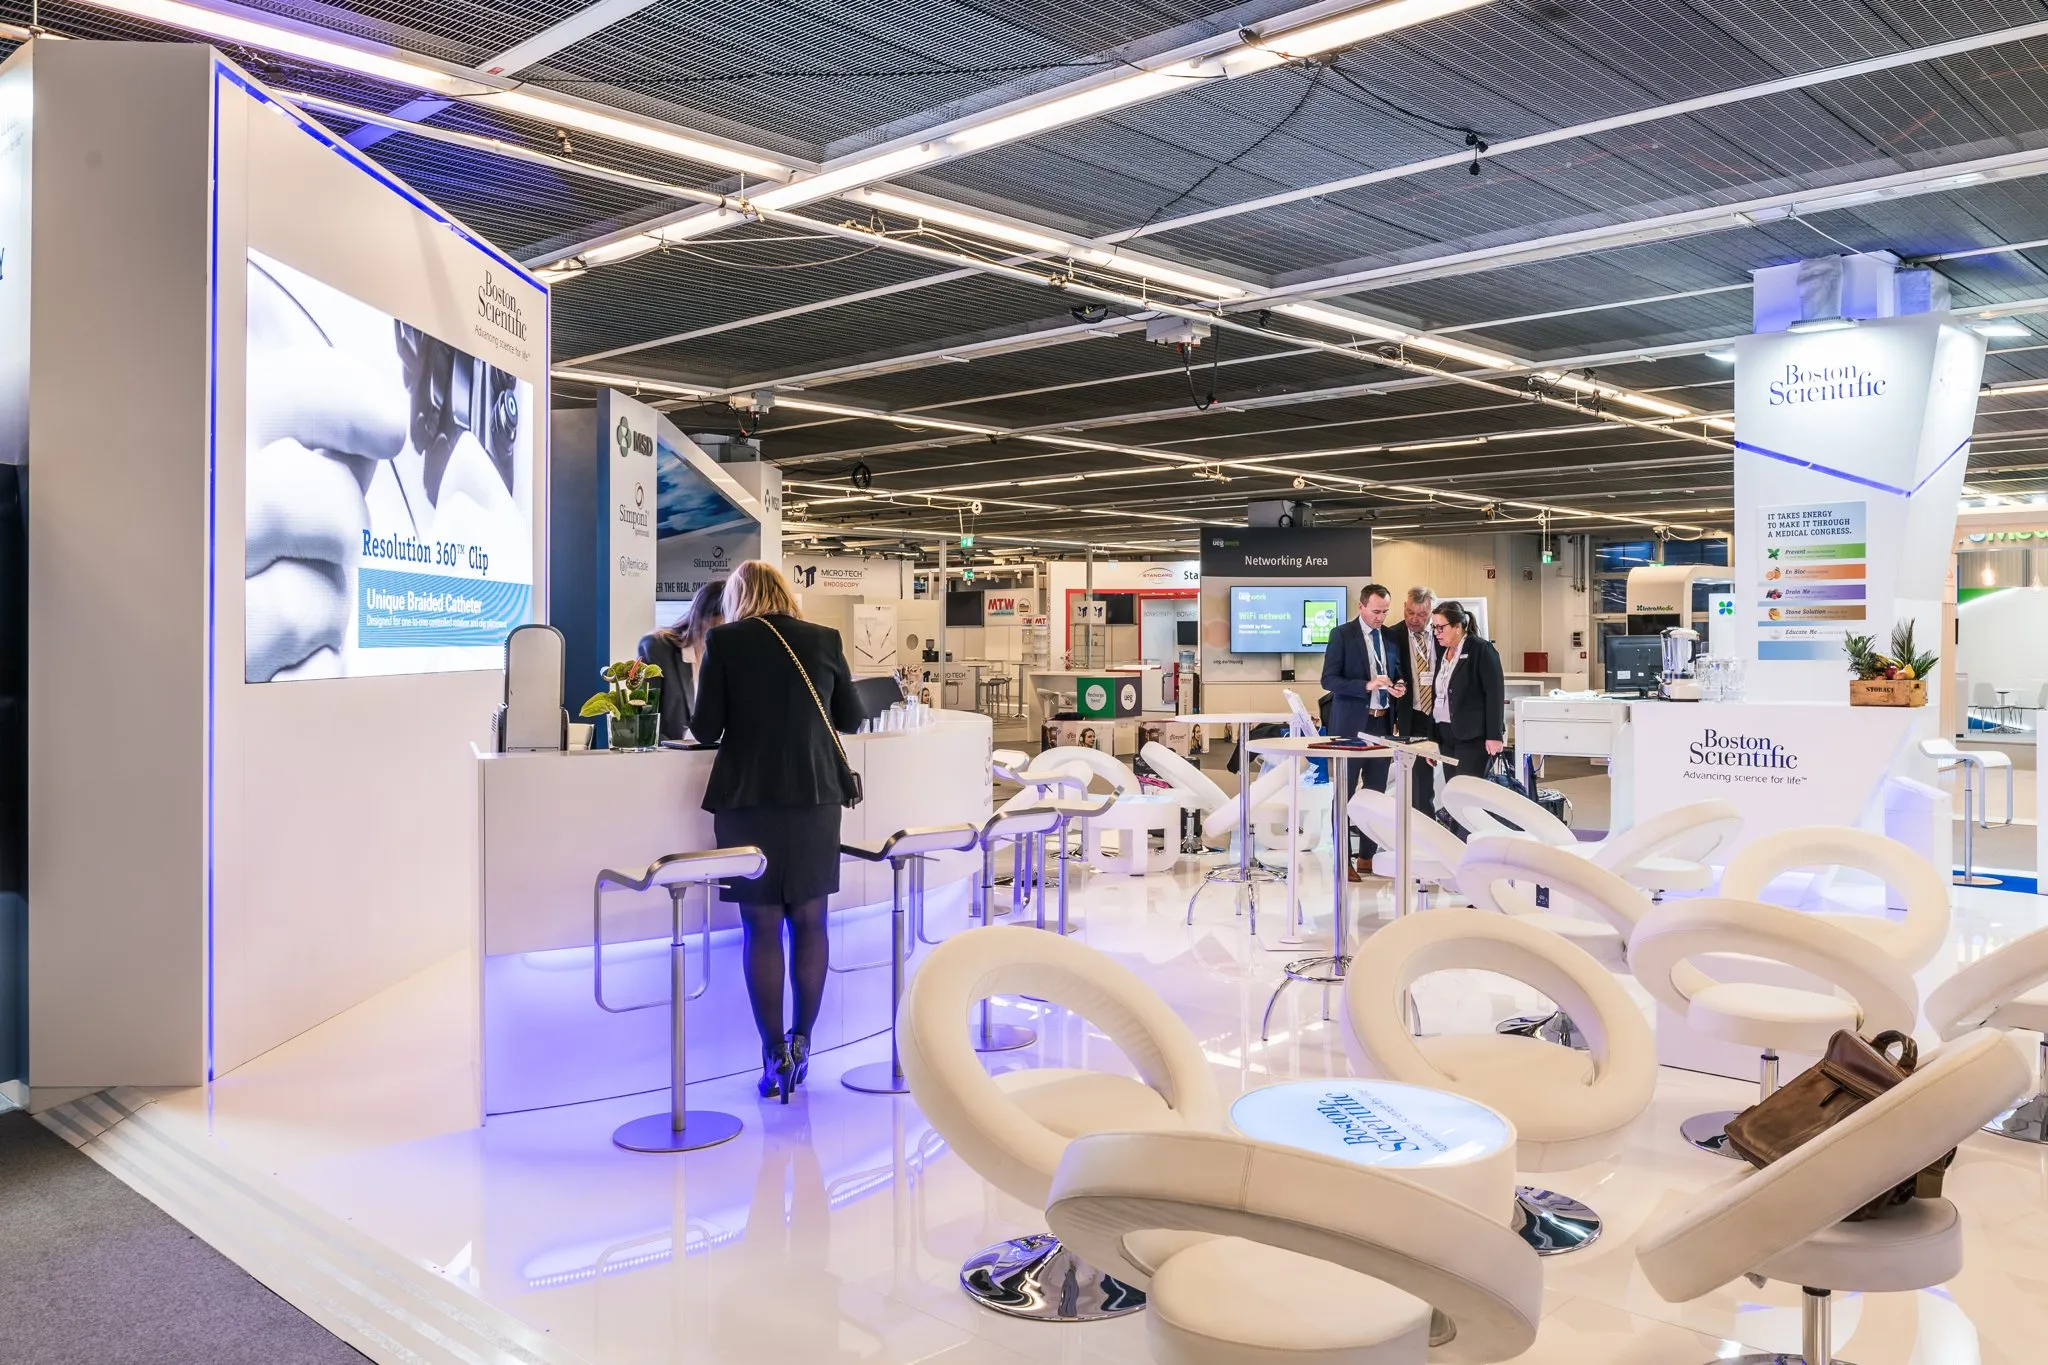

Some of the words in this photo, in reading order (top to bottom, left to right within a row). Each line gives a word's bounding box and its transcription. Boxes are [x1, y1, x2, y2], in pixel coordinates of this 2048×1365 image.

[485, 270, 516, 313] Boston
[478, 285, 527, 341] Scientific
[1786, 364, 1857, 385] Boston
[1769, 371, 1886, 406] Scientific
[633, 430, 654, 457] MSD
[1767, 513, 1776, 521] IT
[1777, 512, 1800, 520] TAKES
[1802, 510, 1833, 519] ENERGY
[1779, 521, 1800, 529] MAKE
[1812, 518, 1850, 527] THROUGH
[1775, 529, 1808, 538] MEDICAL
[1810, 527, 1852, 536] CONGRESS.
[362, 529, 432, 564] Resolution
[468, 545, 489, 576] Clip
[1244, 555, 1303, 568] Networking
[1305, 555, 1329, 566] Area
[664, 582, 675, 593] THE
[676, 582, 690, 593] REAL
[366, 587, 405, 615] Unique
[407, 590, 444, 612] Braided
[445, 593, 484, 614] Catheter
[987, 598, 1015, 611] MTW
[1238, 610, 1256, 621] WiFi
[1258, 611, 1292, 621] network
[1703, 728, 1772, 750] Boston
[1689, 741, 1798, 769] Scientific
[1683, 770, 1731, 783] Advancing
[1734, 774, 1768, 783] science
[1771, 775, 1784, 784] for
[1316, 1106, 1379, 1146] Boston
[1318, 1091, 1422, 1152] Scientific
